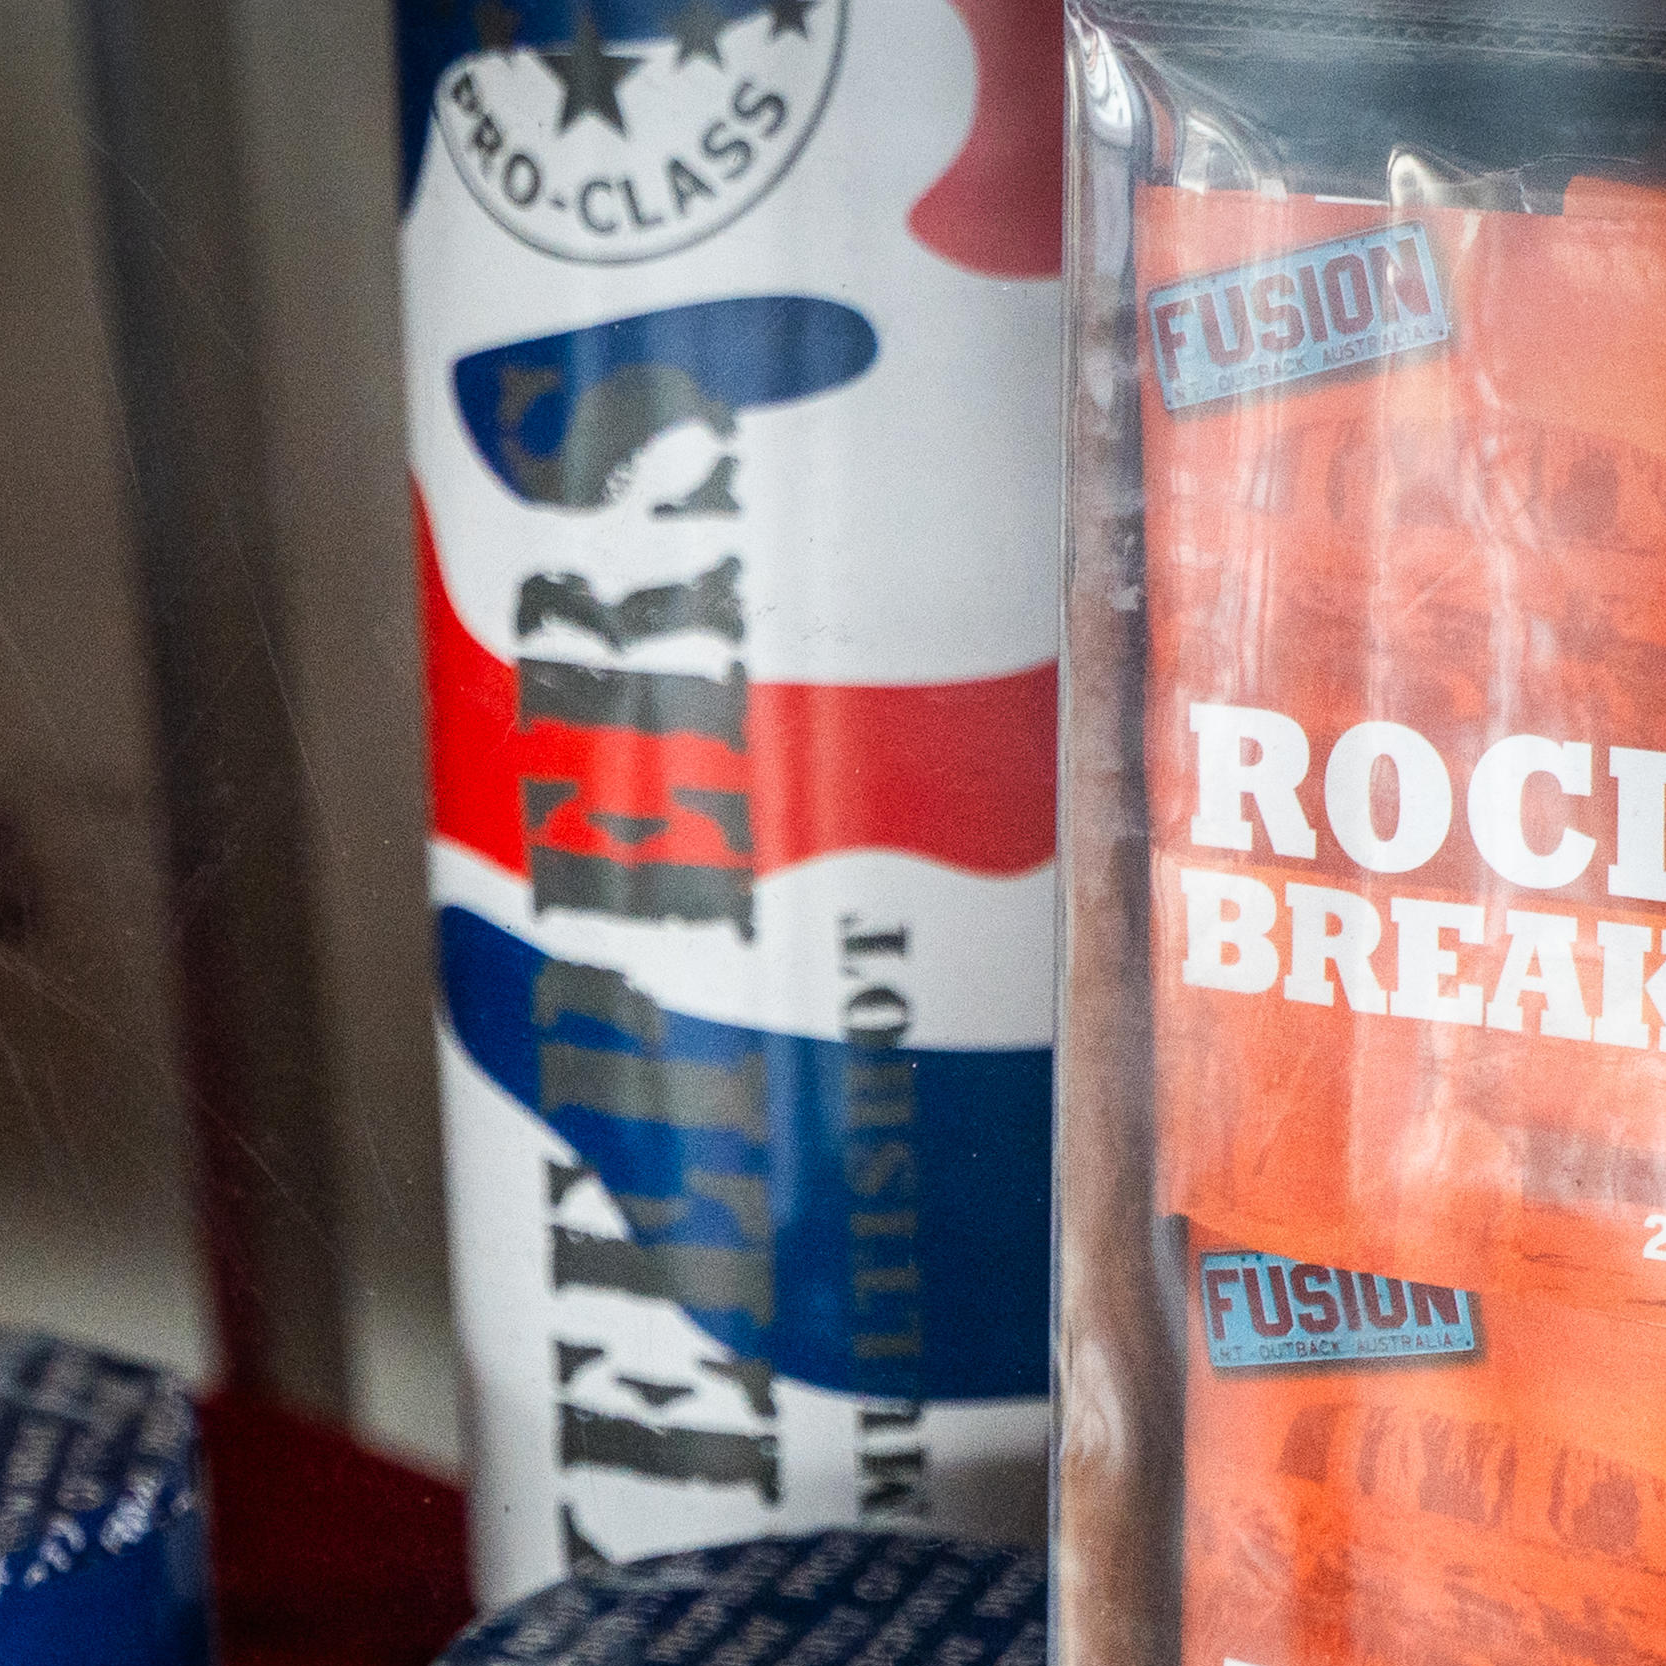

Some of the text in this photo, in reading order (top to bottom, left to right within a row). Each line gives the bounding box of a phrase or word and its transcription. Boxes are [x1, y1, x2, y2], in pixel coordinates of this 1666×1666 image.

[449, 72, 787, 236] PRO-CLASS
[1155, 237, 1432, 384] FUSION
[496, 362, 783, 1575] EEPERS
[841, 905, 925, 1518] MULTISHOT
[1205, 1262, 1461, 1341] FUSION
